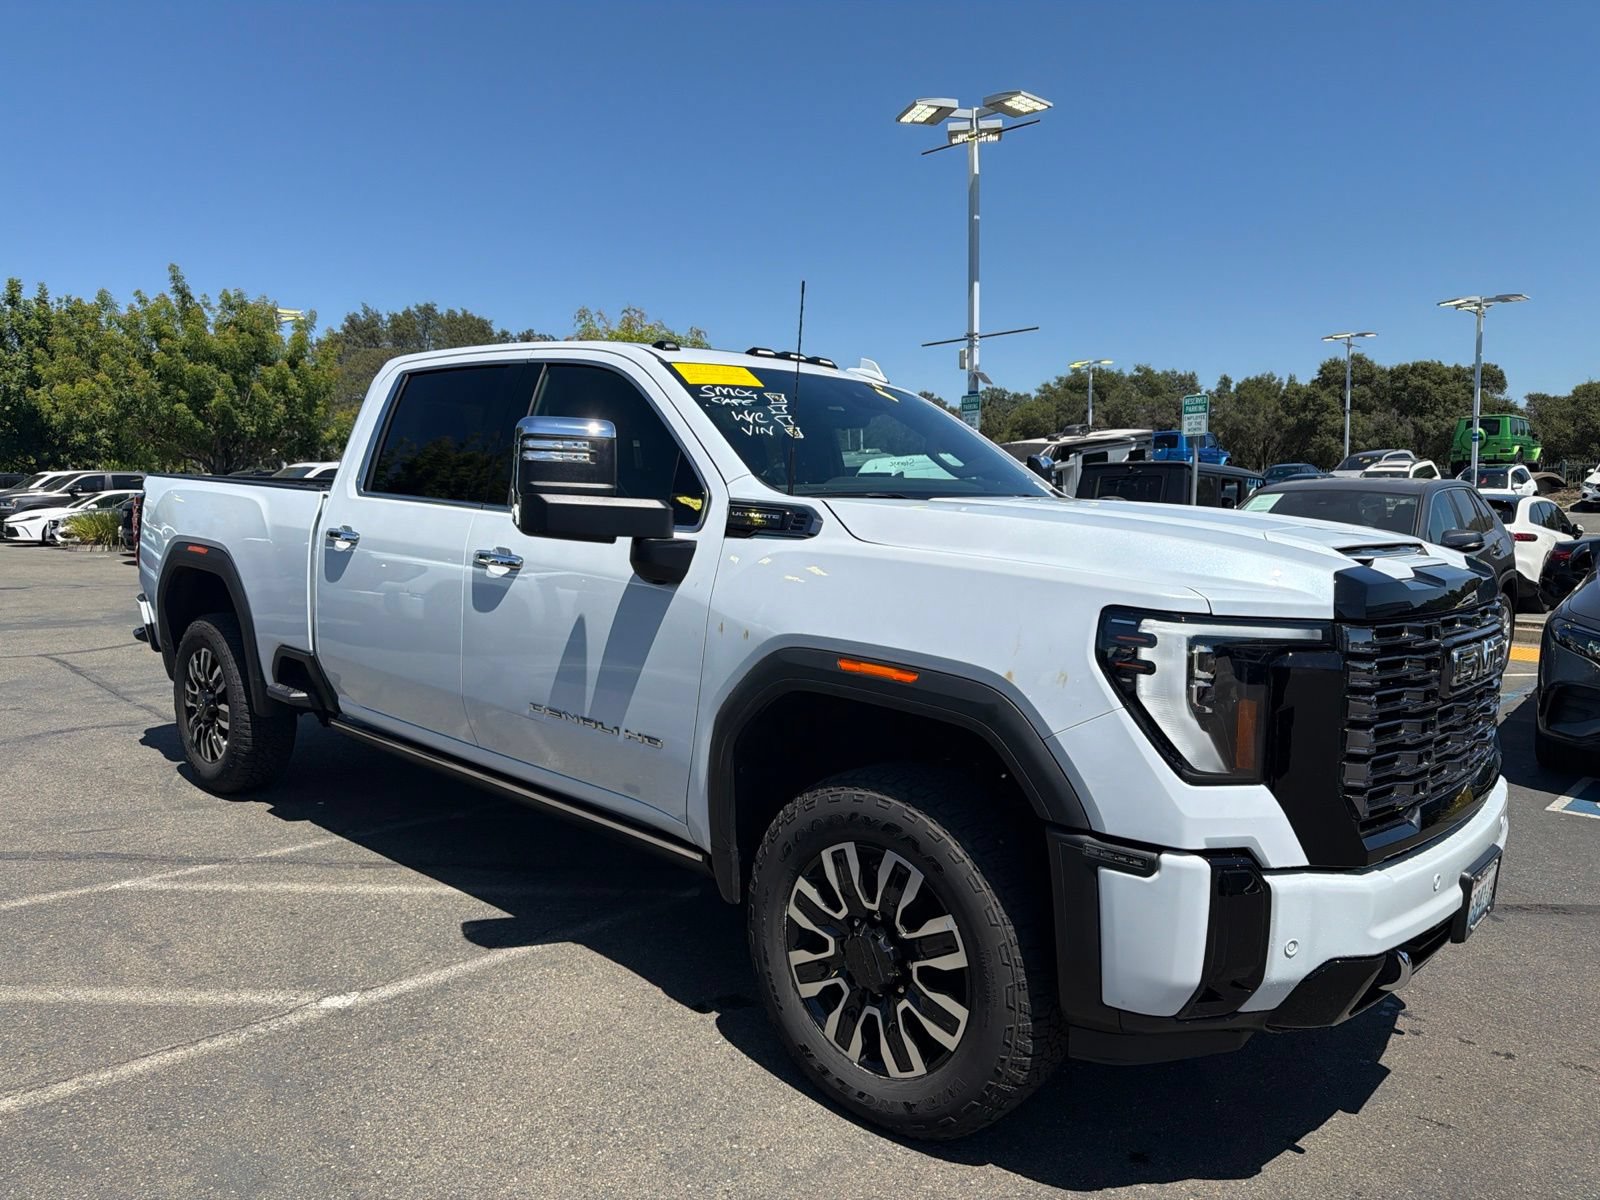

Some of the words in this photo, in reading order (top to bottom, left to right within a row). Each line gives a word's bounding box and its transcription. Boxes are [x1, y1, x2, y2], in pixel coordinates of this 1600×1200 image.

[741, 425, 774, 436] VIN
[731, 510, 780, 520] ULTIMATE
[529, 702, 619, 736] DENALI
[624, 729, 663, 749] HD
[797, 1043, 968, 1115] WRANGLER
